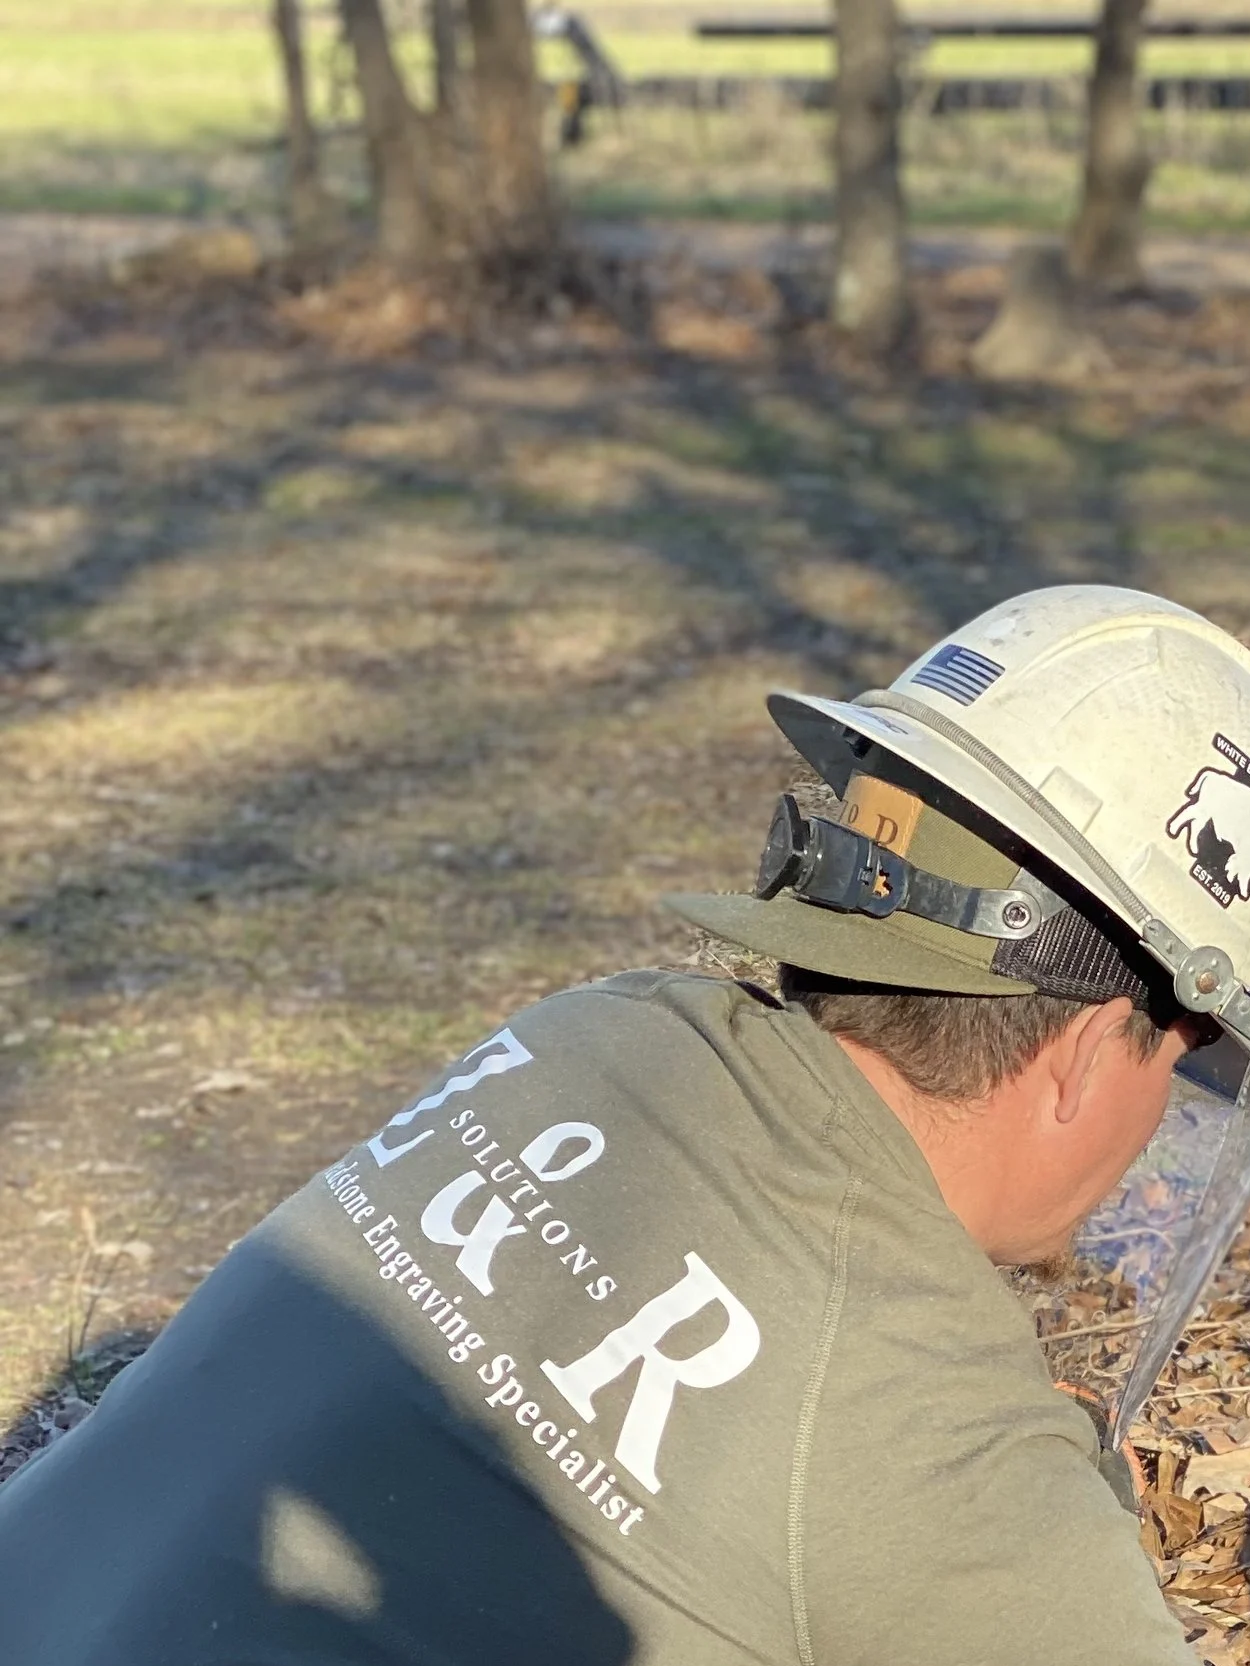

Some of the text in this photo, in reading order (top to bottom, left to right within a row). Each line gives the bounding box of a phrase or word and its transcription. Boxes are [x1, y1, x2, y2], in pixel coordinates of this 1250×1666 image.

[1216, 736, 1247, 769] WHITE
[1192, 864, 1232, 905] EST. 2019
[366, 1027, 534, 1169] Z
[540, 1250, 761, 1496] R
[449, 1109, 617, 1301] SOLUTIONS
[362, 1214, 485, 1364] Engraving
[477, 1353, 646, 1536] Specialist
